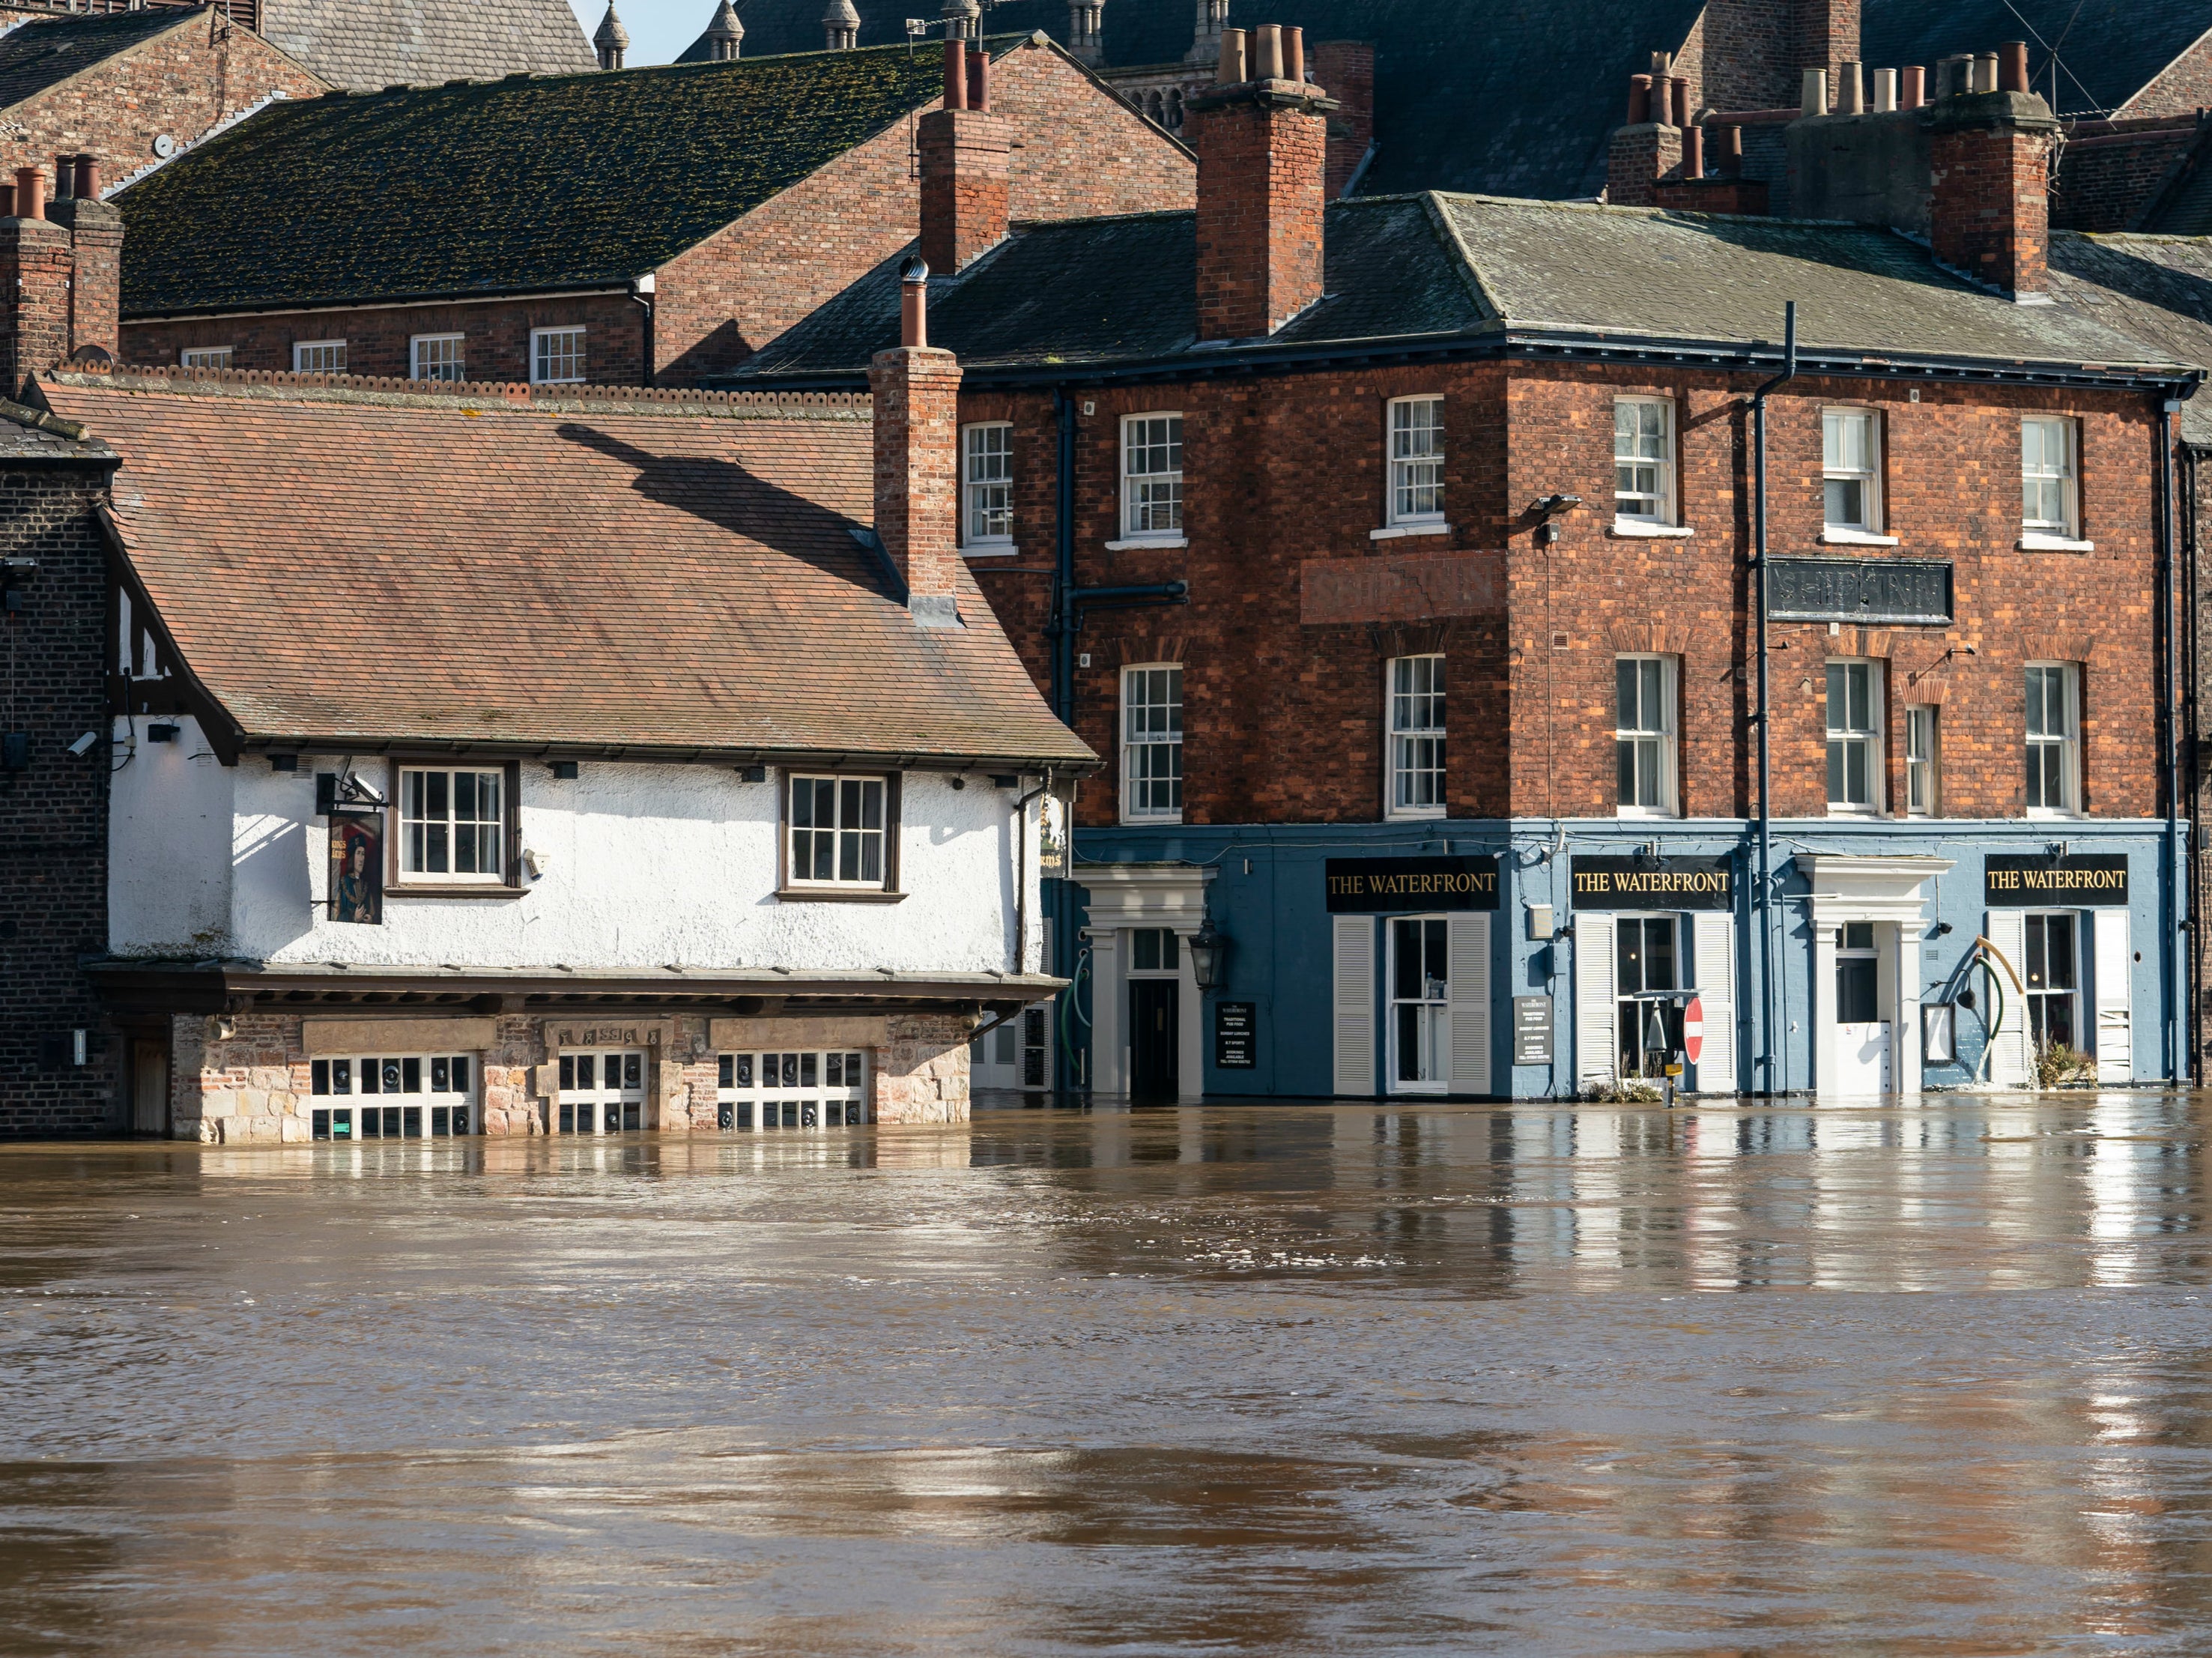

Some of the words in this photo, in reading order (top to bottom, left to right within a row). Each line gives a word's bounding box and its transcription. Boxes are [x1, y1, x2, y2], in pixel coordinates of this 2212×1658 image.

[1328, 875, 1364, 894] THE
[1369, 873, 1497, 894] WATERFRONT
[1575, 873, 1610, 892] THE
[1613, 872, 1730, 892] WATERFRONT
[1987, 871, 2020, 889] THE
[2022, 870, 2126, 889] WATERFRONT
